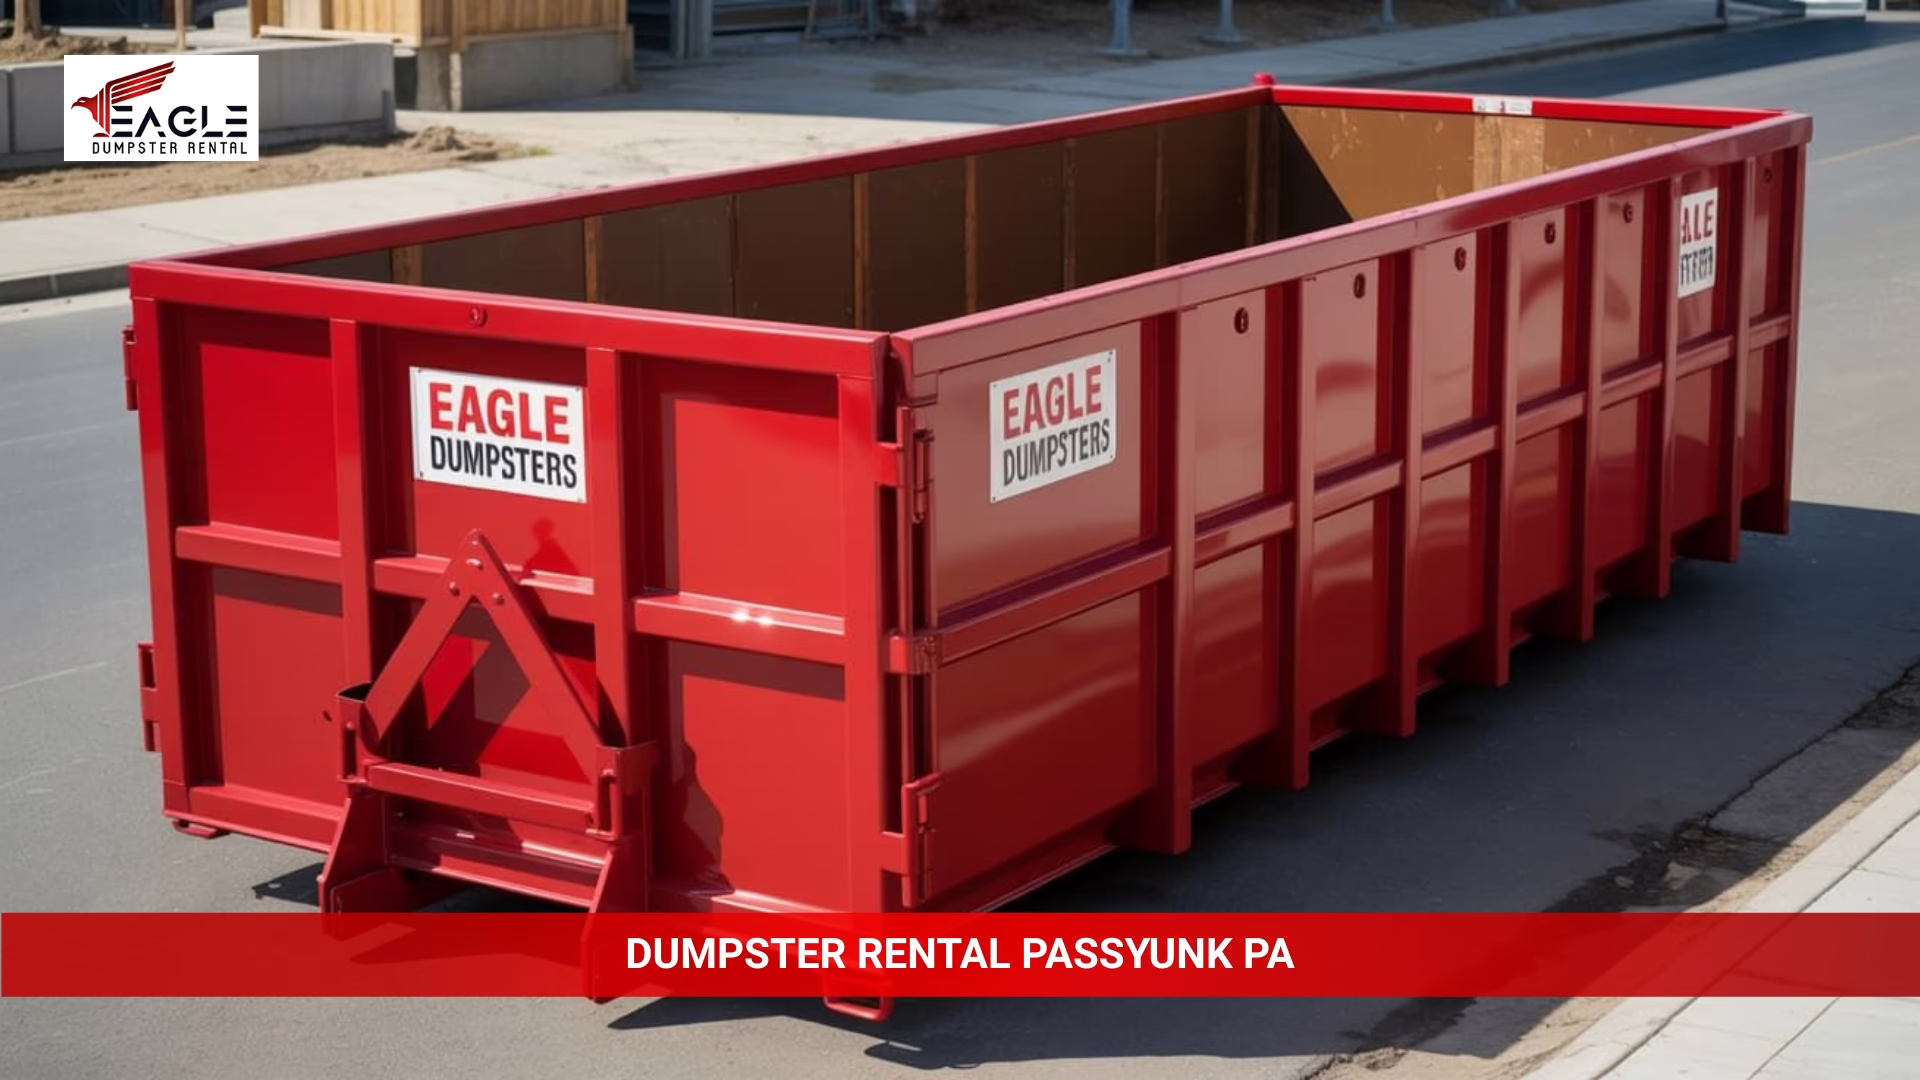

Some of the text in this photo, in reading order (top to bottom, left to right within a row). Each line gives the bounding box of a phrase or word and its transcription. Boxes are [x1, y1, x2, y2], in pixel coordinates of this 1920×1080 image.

[429, 382, 570, 444] EAGLE
[1003, 365, 1102, 440] EAGLE
[430, 435, 578, 489] DUMPSTERS
[1003, 418, 1110, 487] DUMPSTERS
